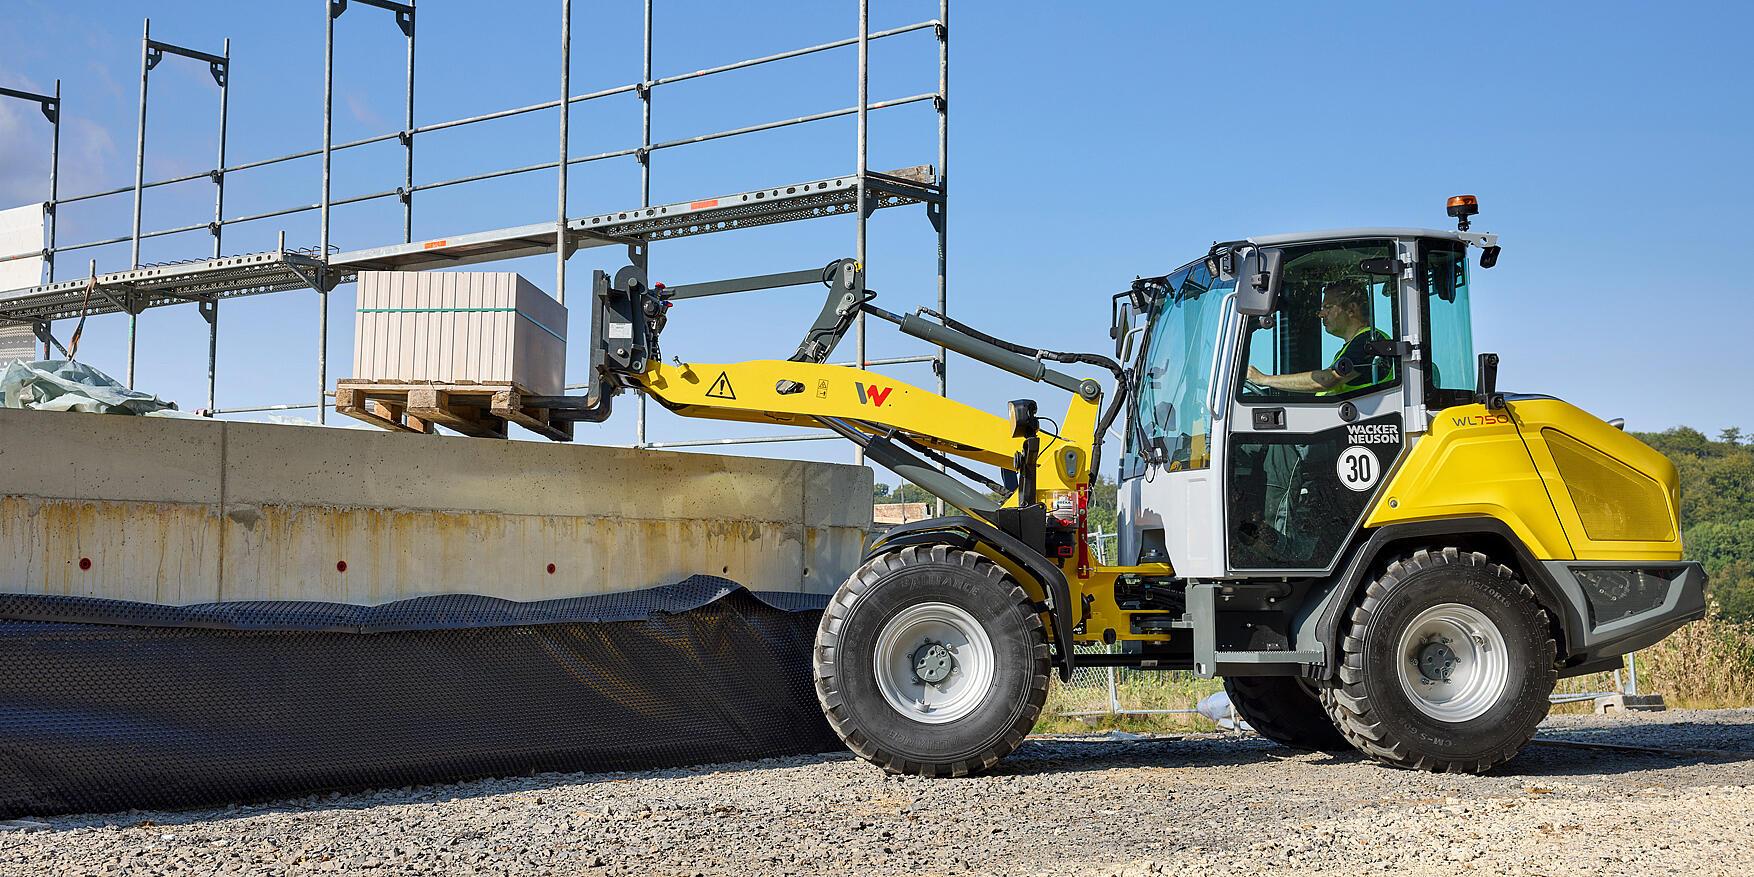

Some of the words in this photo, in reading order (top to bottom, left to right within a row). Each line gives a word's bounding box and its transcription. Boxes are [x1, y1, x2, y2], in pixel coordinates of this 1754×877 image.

[1452, 415, 1509, 427] WL750
[1347, 424, 1399, 434] WACKER
[1348, 434, 1399, 444] NEUSON
[1345, 454, 1371, 483] 30
